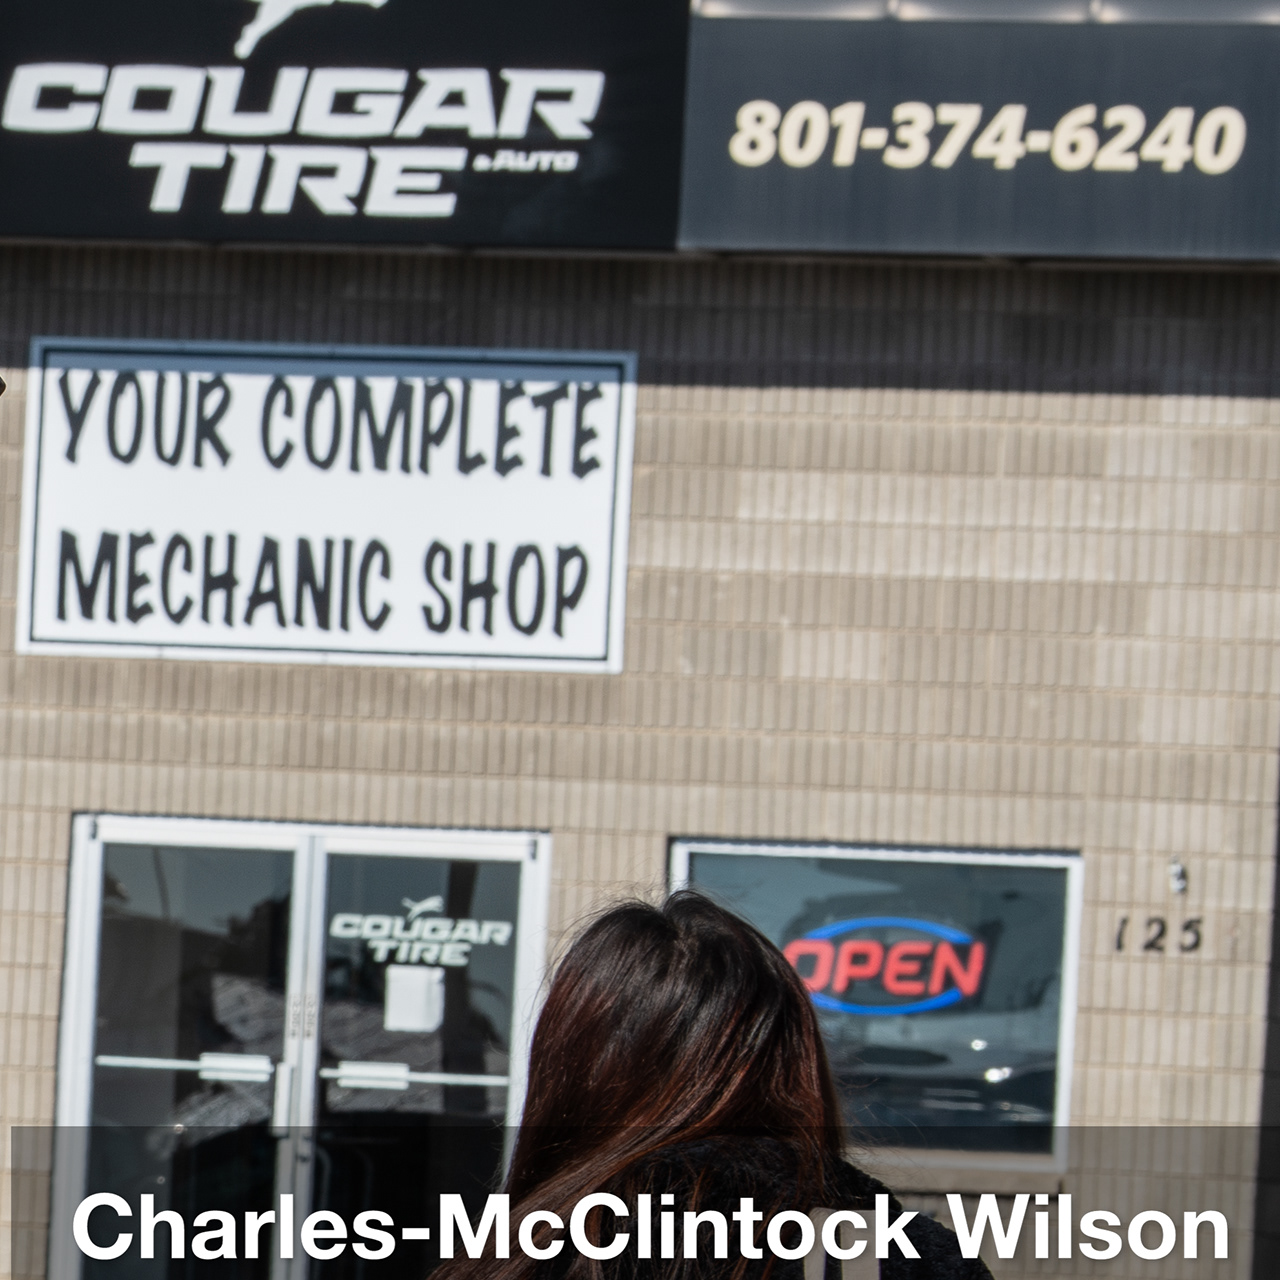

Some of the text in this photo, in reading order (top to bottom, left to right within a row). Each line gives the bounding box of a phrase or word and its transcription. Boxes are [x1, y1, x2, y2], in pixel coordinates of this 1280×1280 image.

[1, 62, 605, 140] COUGAR
[729, 100, 1247, 175] 801-374-6240
[129, 142, 467, 218] TIRE
[58, 369, 603, 479] YOUR COMPLETE
[55, 529, 589, 638] MECHANIC SHOP
[329, 912, 514, 946] COUGAR
[367, 938, 472, 967] TIRE
[1115, 916, 1203, 953] 125
[783, 938, 985, 996] OPEN
